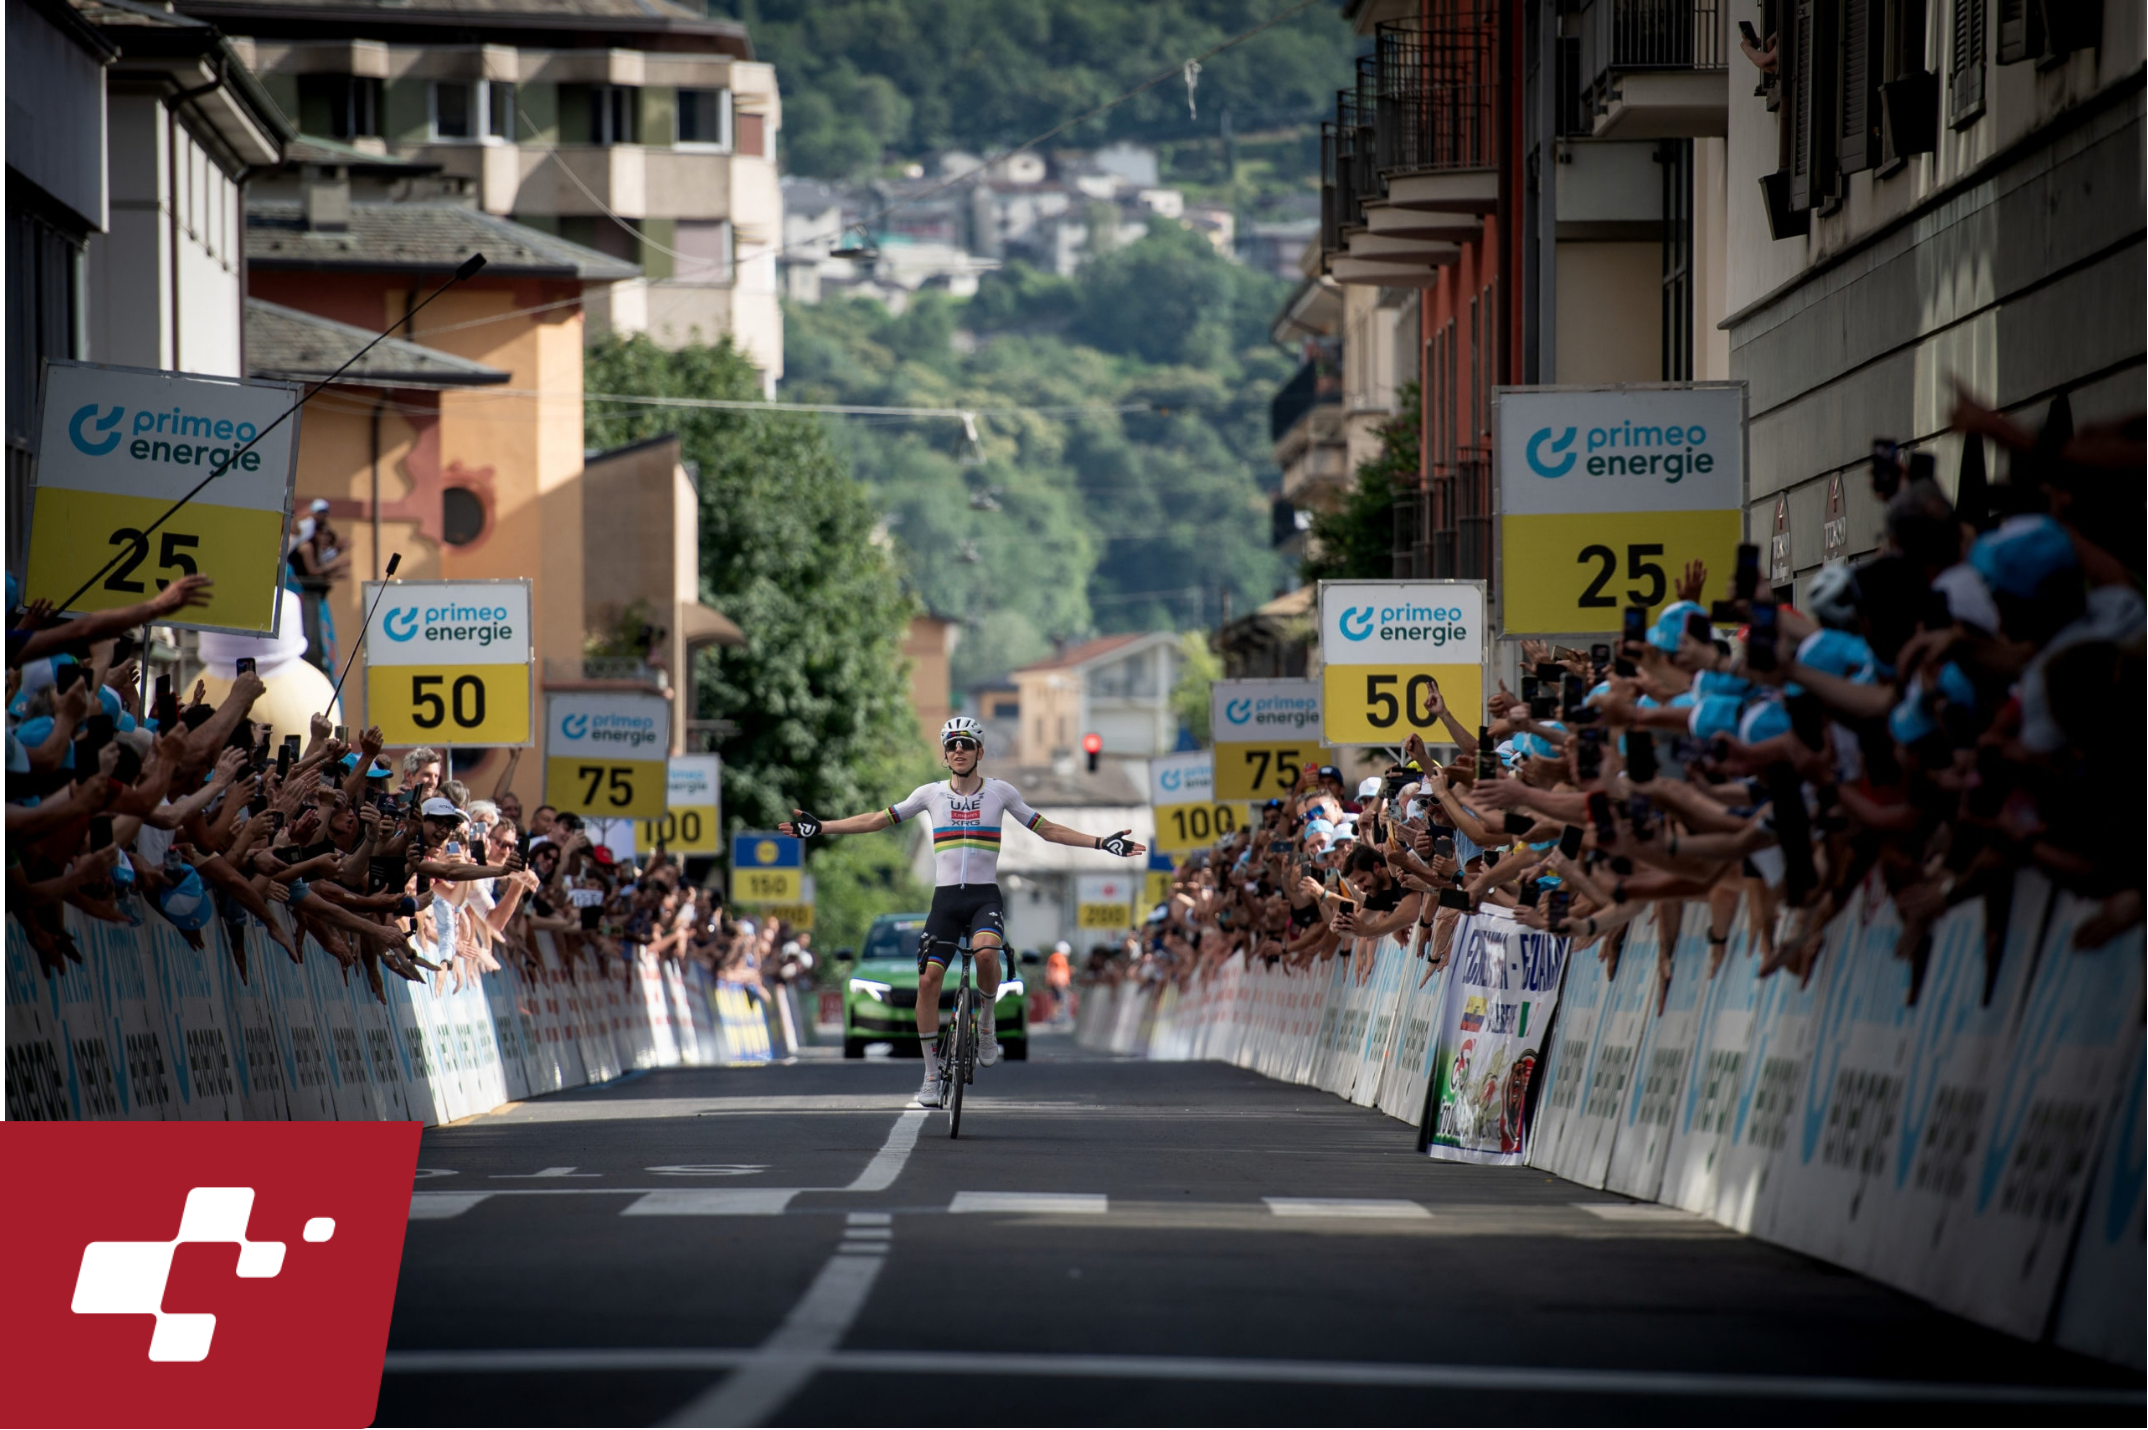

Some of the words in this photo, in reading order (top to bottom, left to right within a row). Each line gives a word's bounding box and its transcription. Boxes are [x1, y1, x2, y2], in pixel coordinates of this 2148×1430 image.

[133, 407, 257, 440] primeo
[1587, 420, 1706, 448] primeo
[130, 437, 261, 477] energie
[1586, 446, 1715, 483] energie
[104, 527, 200, 593] 25
[1577, 544, 1667, 608] 25
[425, 603, 507, 624] primeo
[1381, 603, 1462, 626] primeo
[425, 621, 513, 646] energie
[1380, 622, 1467, 646] energie
[411, 674, 486, 729] 50
[1256, 694, 1316, 712] primeo
[1366, 674, 1440, 729] 50
[592, 714, 654, 729] primeo
[1256, 708, 1319, 729] energie
[592, 727, 656, 748] energie
[1245, 750, 1300, 790] 75
[578, 766, 634, 807] 75
[950, 797, 981, 811] UAE
[645, 810, 701, 843] 100
[1171, 804, 1234, 841] 100
[750, 874, 788, 896] 150
